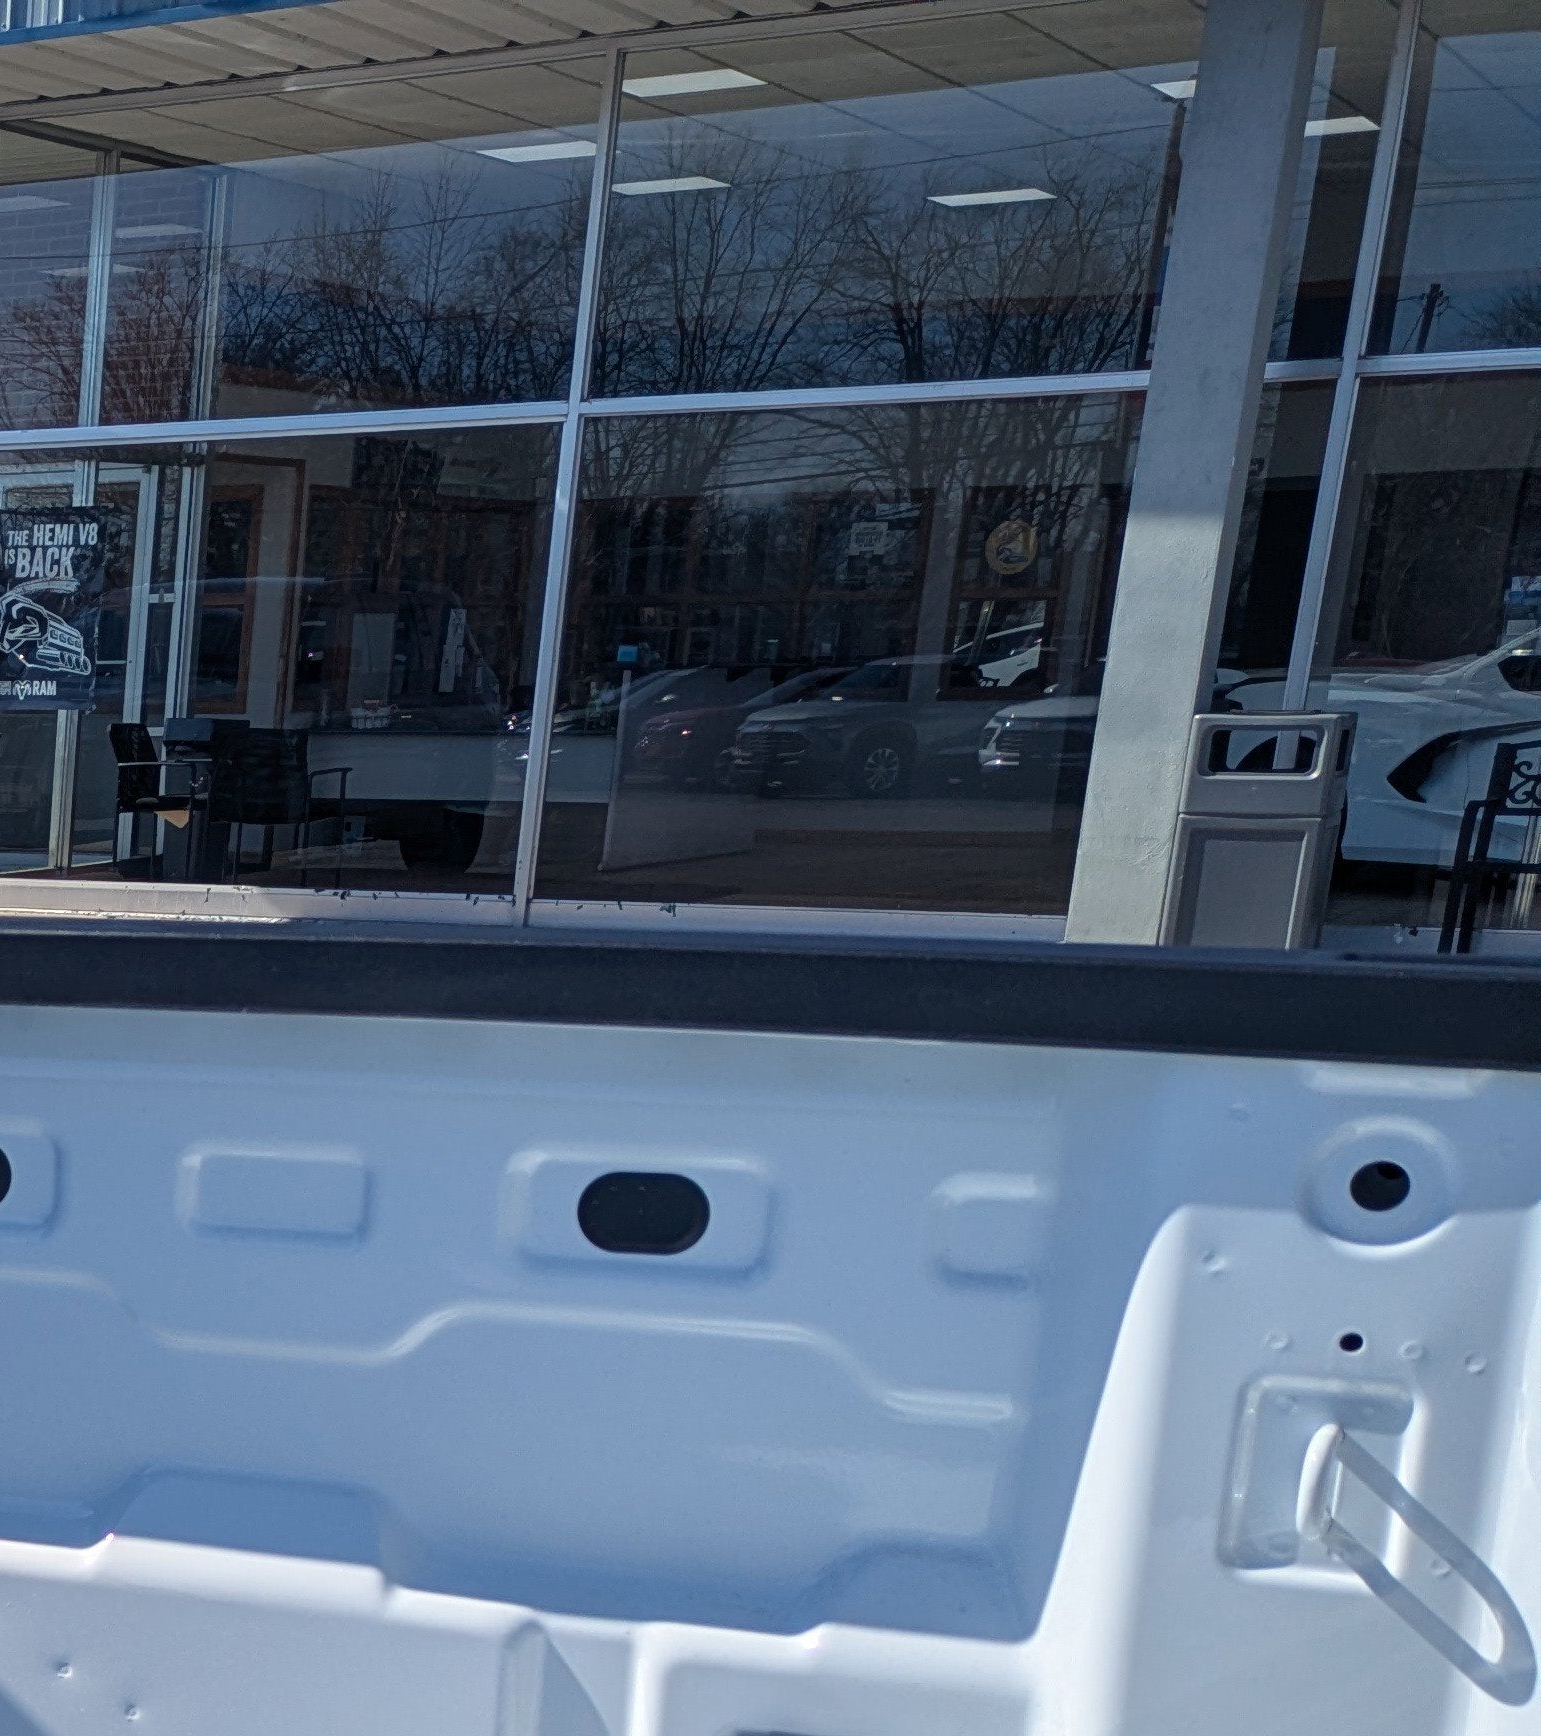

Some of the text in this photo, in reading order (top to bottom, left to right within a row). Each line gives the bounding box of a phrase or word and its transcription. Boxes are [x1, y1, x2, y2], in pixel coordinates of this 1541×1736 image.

[7, 523, 98, 546] THE HEMI V8
[4, 547, 75, 578] IS BACK
[32, 680, 57, 696] RAM
